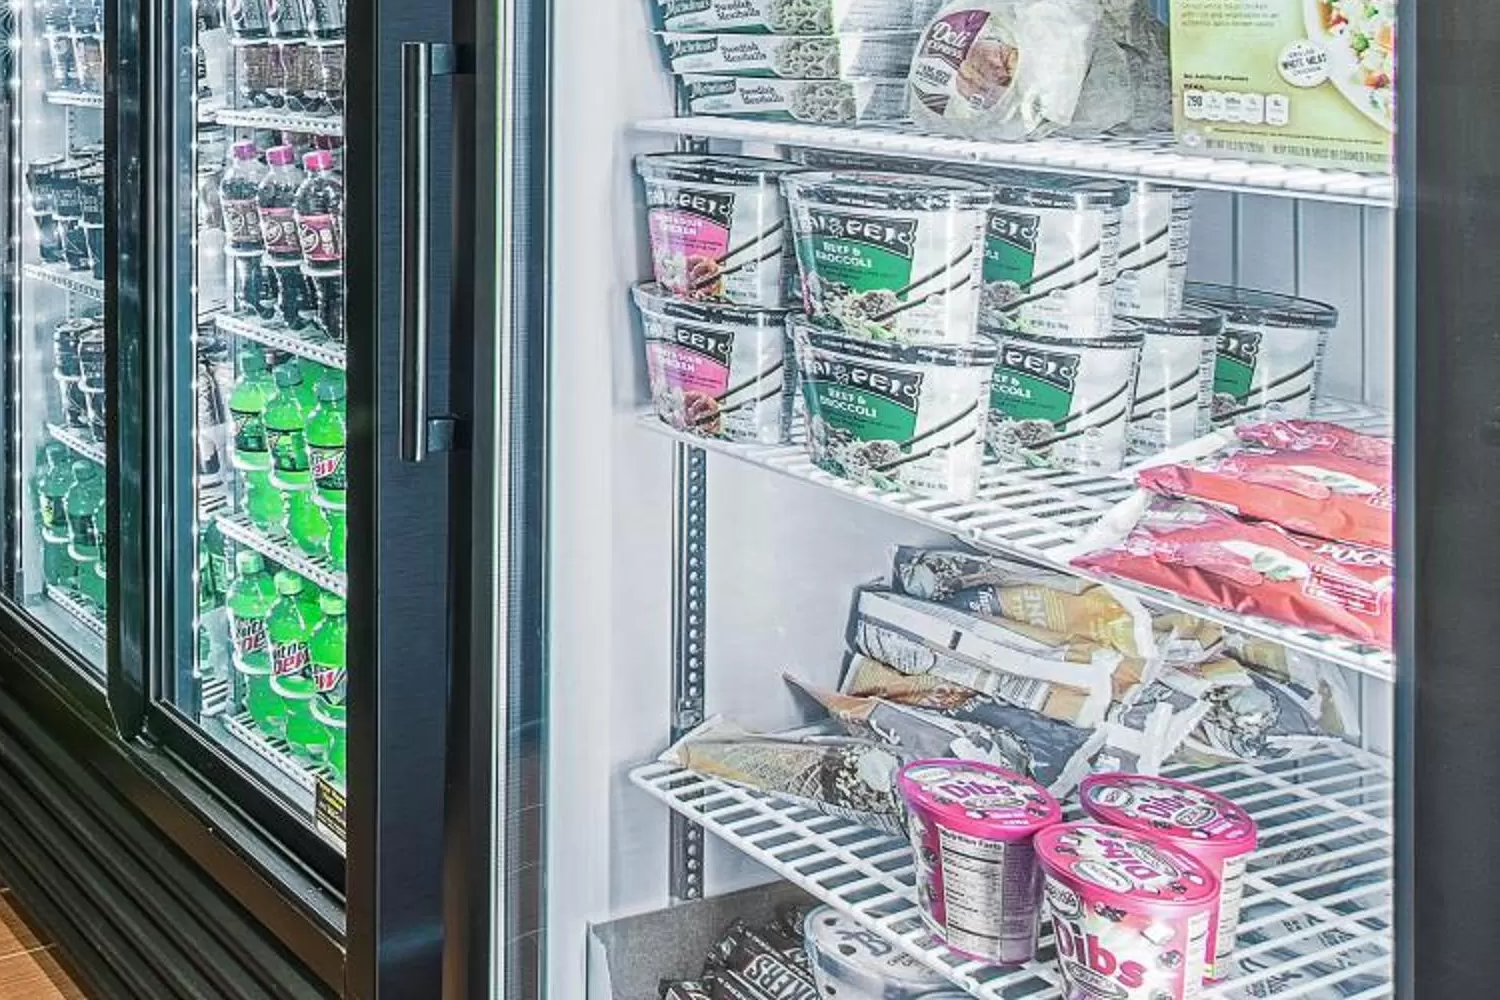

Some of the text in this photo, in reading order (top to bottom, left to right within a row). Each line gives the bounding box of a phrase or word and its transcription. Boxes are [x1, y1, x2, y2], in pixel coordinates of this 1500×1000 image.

[931, 21, 971, 48] Deli
[815, 249, 873, 269] BROCCOLI
[818, 396, 877, 419] BROCCOLI
[941, 779, 1017, 802] Dibs
[1051, 912, 1148, 989] Dibs
